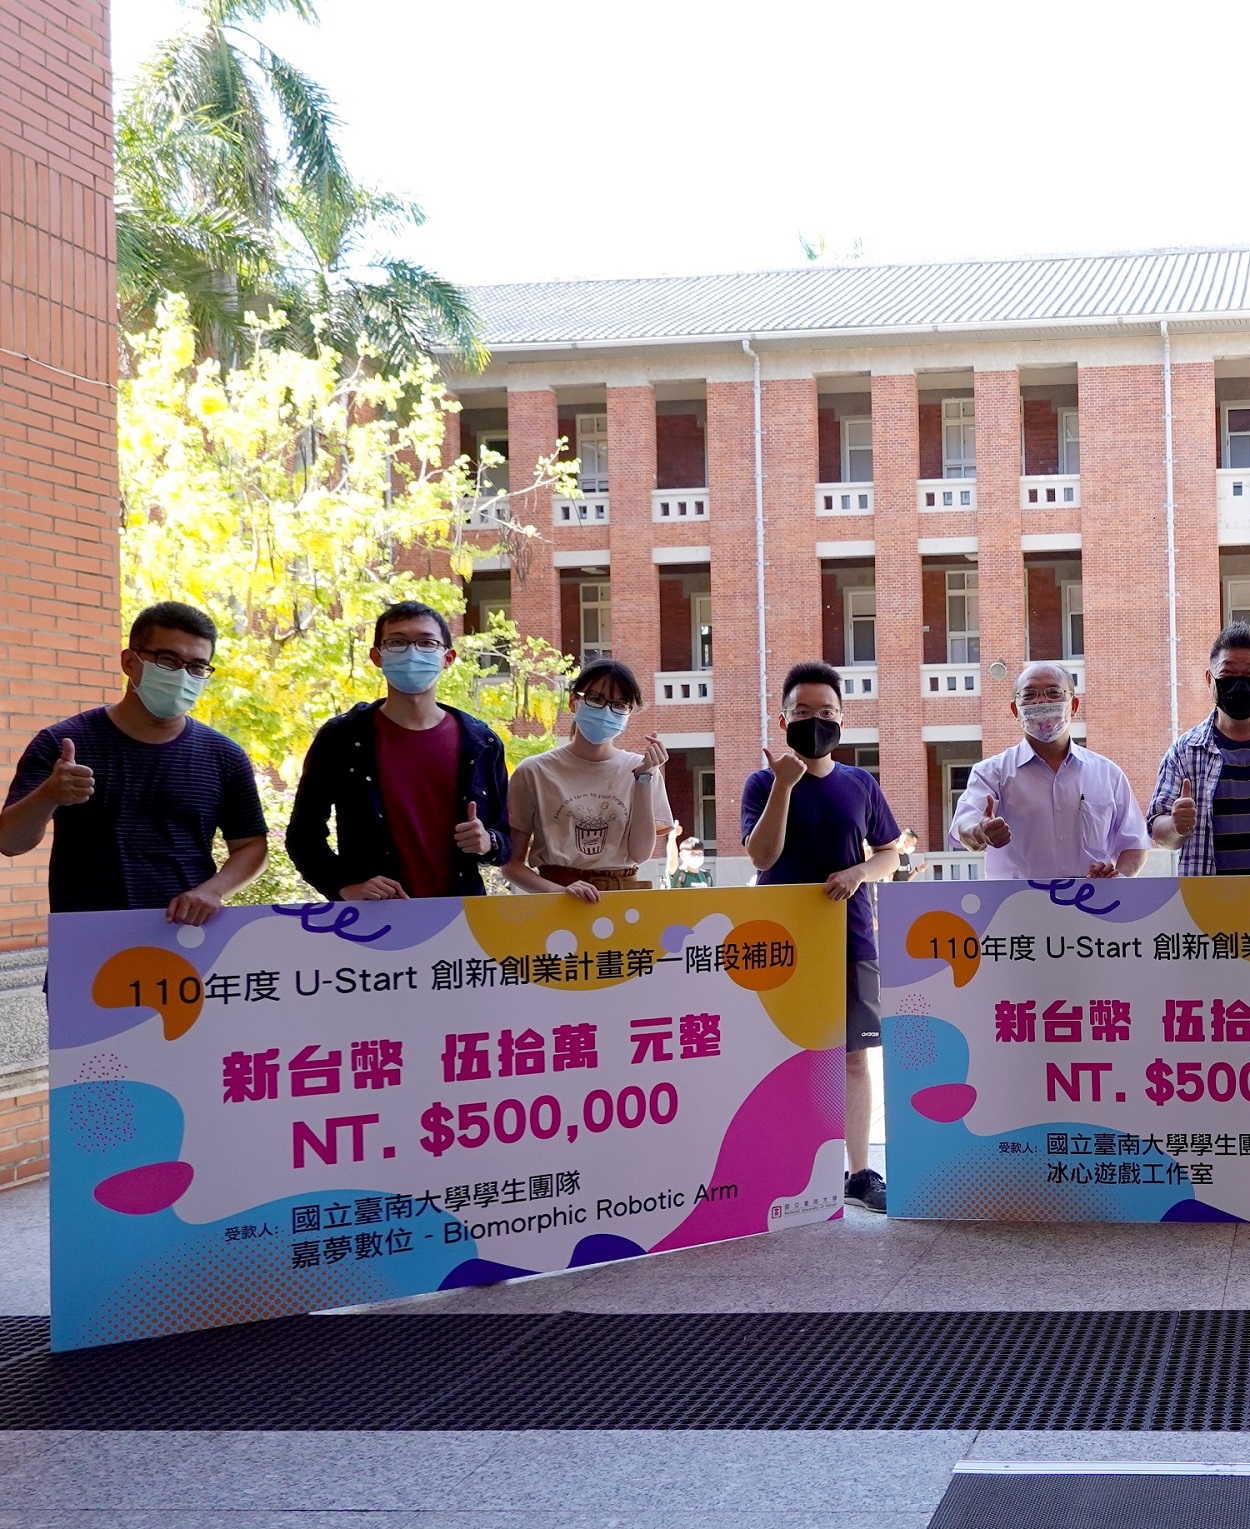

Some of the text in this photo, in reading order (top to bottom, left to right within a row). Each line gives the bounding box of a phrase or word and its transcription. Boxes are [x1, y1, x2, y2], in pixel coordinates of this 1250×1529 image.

[129, 940, 796, 1007] 110年度 U-Start 創新創業計畫第一階段補助
[929, 934, 1036, 962] 110年度
[1046, 936, 1143, 958] U-Start
[994, 999, 1132, 1043] 新台幣
[222, 1013, 722, 1104] 新台幣 伍拾萬 元整
[1046, 1062, 1126, 1103] NT.
[292, 1082, 679, 1169] NT. $500,000
[291, 1169, 581, 1235] 國立臺南大學學生團隊
[1046, 1161, 1214, 1186] 冰心遊戲工作室
[291, 1227, 414, 1270] 嘉夢數位
[443, 1203, 588, 1245] Biomorphic
[595, 1187, 686, 1221] Robotic
[693, 1182, 738, 1205] Arm
